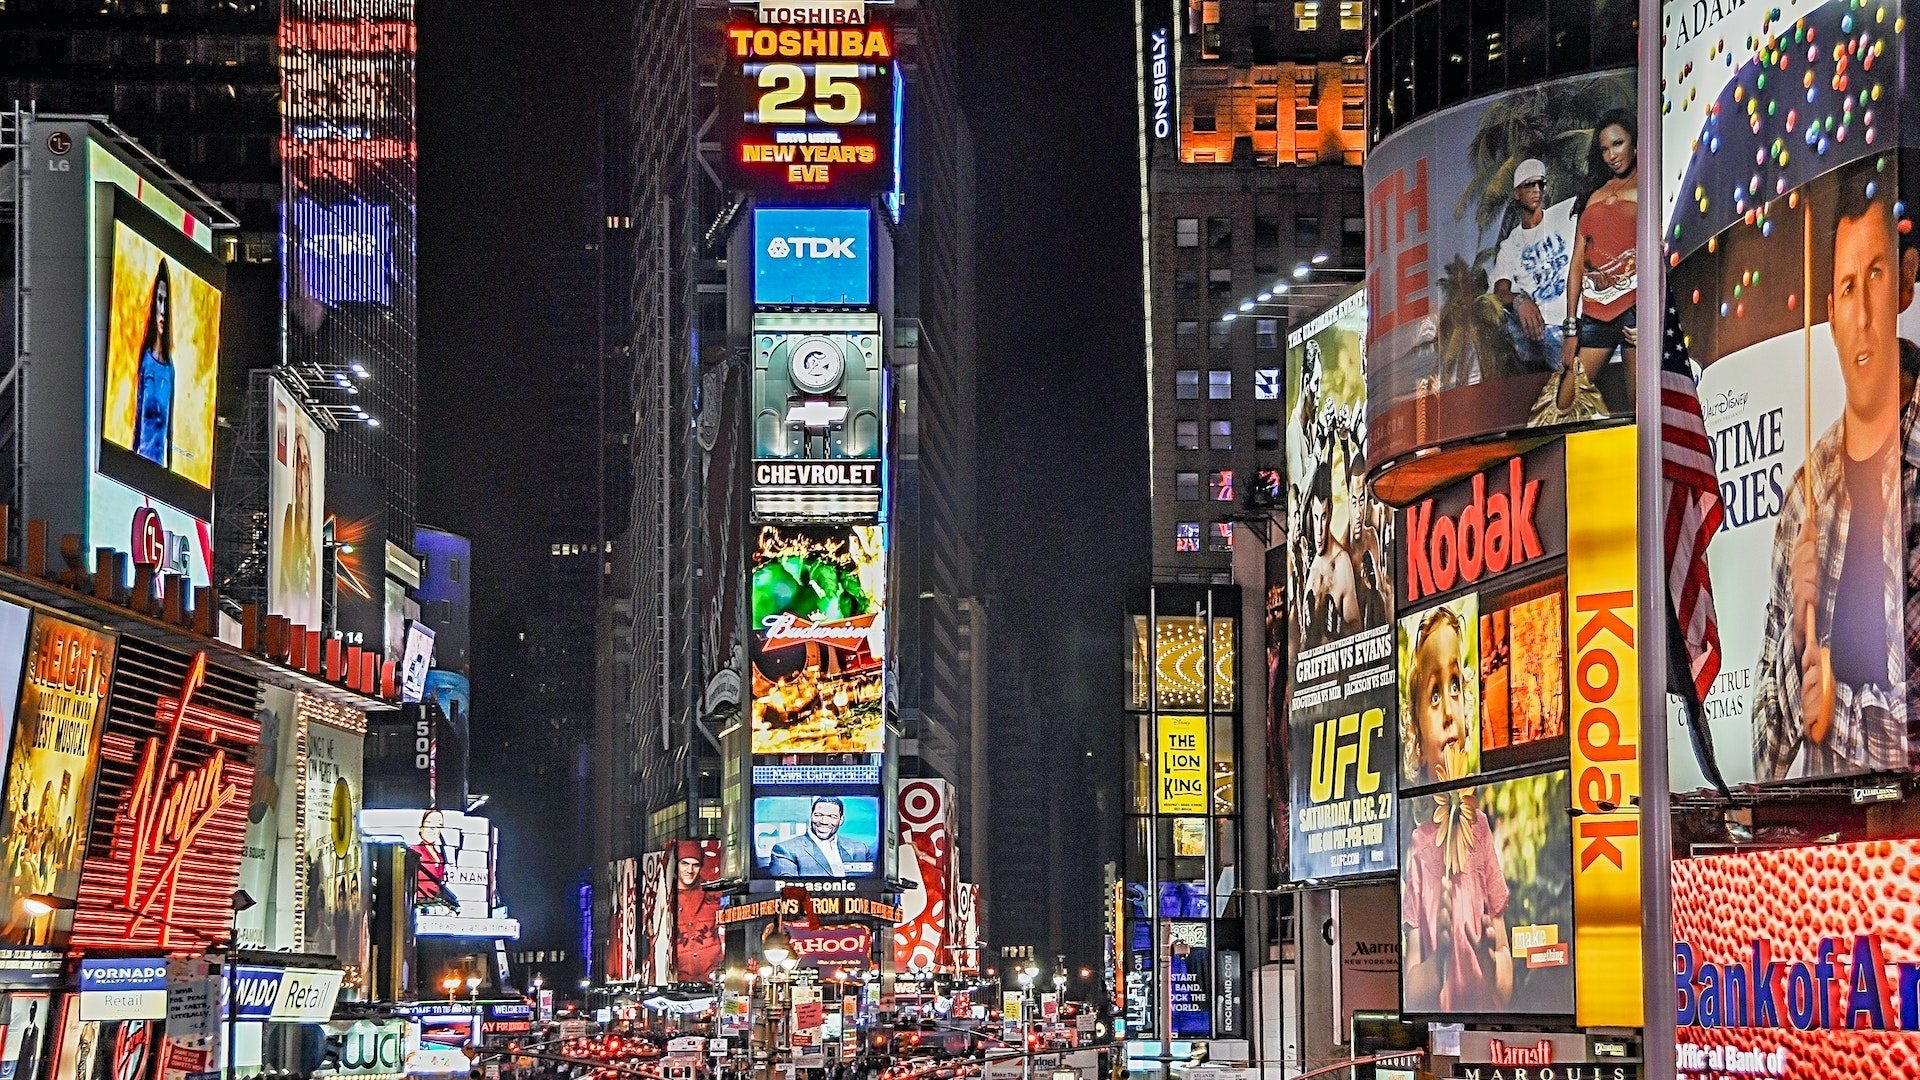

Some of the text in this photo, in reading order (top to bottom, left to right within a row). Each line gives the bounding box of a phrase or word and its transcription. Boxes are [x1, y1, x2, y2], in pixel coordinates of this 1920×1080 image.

[763, 8, 861, 23] TOSHIBA
[730, 30, 889, 57] TOSHIBA
[758, 63, 861, 124] 25
[1152, 27, 1168, 138] ONSIBLY.
[49, 159, 70, 172] LG
[743, 145, 875, 163] NEW YEAR'S
[788, 165, 829, 182] EVE
[787, 237, 856, 258] TDK
[757, 465, 876, 485] CHEVROLET
[1406, 457, 1544, 602] Kodak
[163, 531, 190, 577] LG
[347, 631, 363, 644] 14
[34, 627, 109, 698] HEIGHTS
[1296, 651, 1339, 683] GRIFFIN
[1340, 646, 1354, 670] VS
[1355, 633, 1393, 666] EVANS
[1719, 668, 1750, 693] TRUE
[1678, 695, 1744, 727] CSTMAS
[33, 714, 89, 757] BEST MUSICAL
[416, 704, 430, 770] 1500
[1169, 734, 1195, 747] THE
[1575, 590, 1640, 873] Kodak
[1164, 752, 1201, 774] LION
[1310, 707, 1386, 804] UFC
[128, 652, 236, 947] Virgin
[1164, 778, 1202, 800] KING
[1299, 793, 1392, 832] SATURDAY, DEC. 27
[775, 880, 856, 892] Pasonic
[810, 898, 838, 914] ROM
[1171, 924, 1195, 935] OCK
[1514, 924, 1547, 949] make
[82, 967, 166, 980] VORNADO
[1171, 973, 1198, 981] START
[1675, 938, 1780, 1030] Bank
[1788, 936, 1836, 1031] of
[105, 994, 143, 1007] Retail
[285, 980, 331, 1008] Retail
[1171, 993, 1207, 1001] OCK THE
[1224, 955, 1233, 1031] ROCKBAND.COM
[1725, 1045, 1765, 1073] Bank
[1767, 1045, 1784, 1076] of
[1465, 1067, 1625, 1080] MARQUIS
